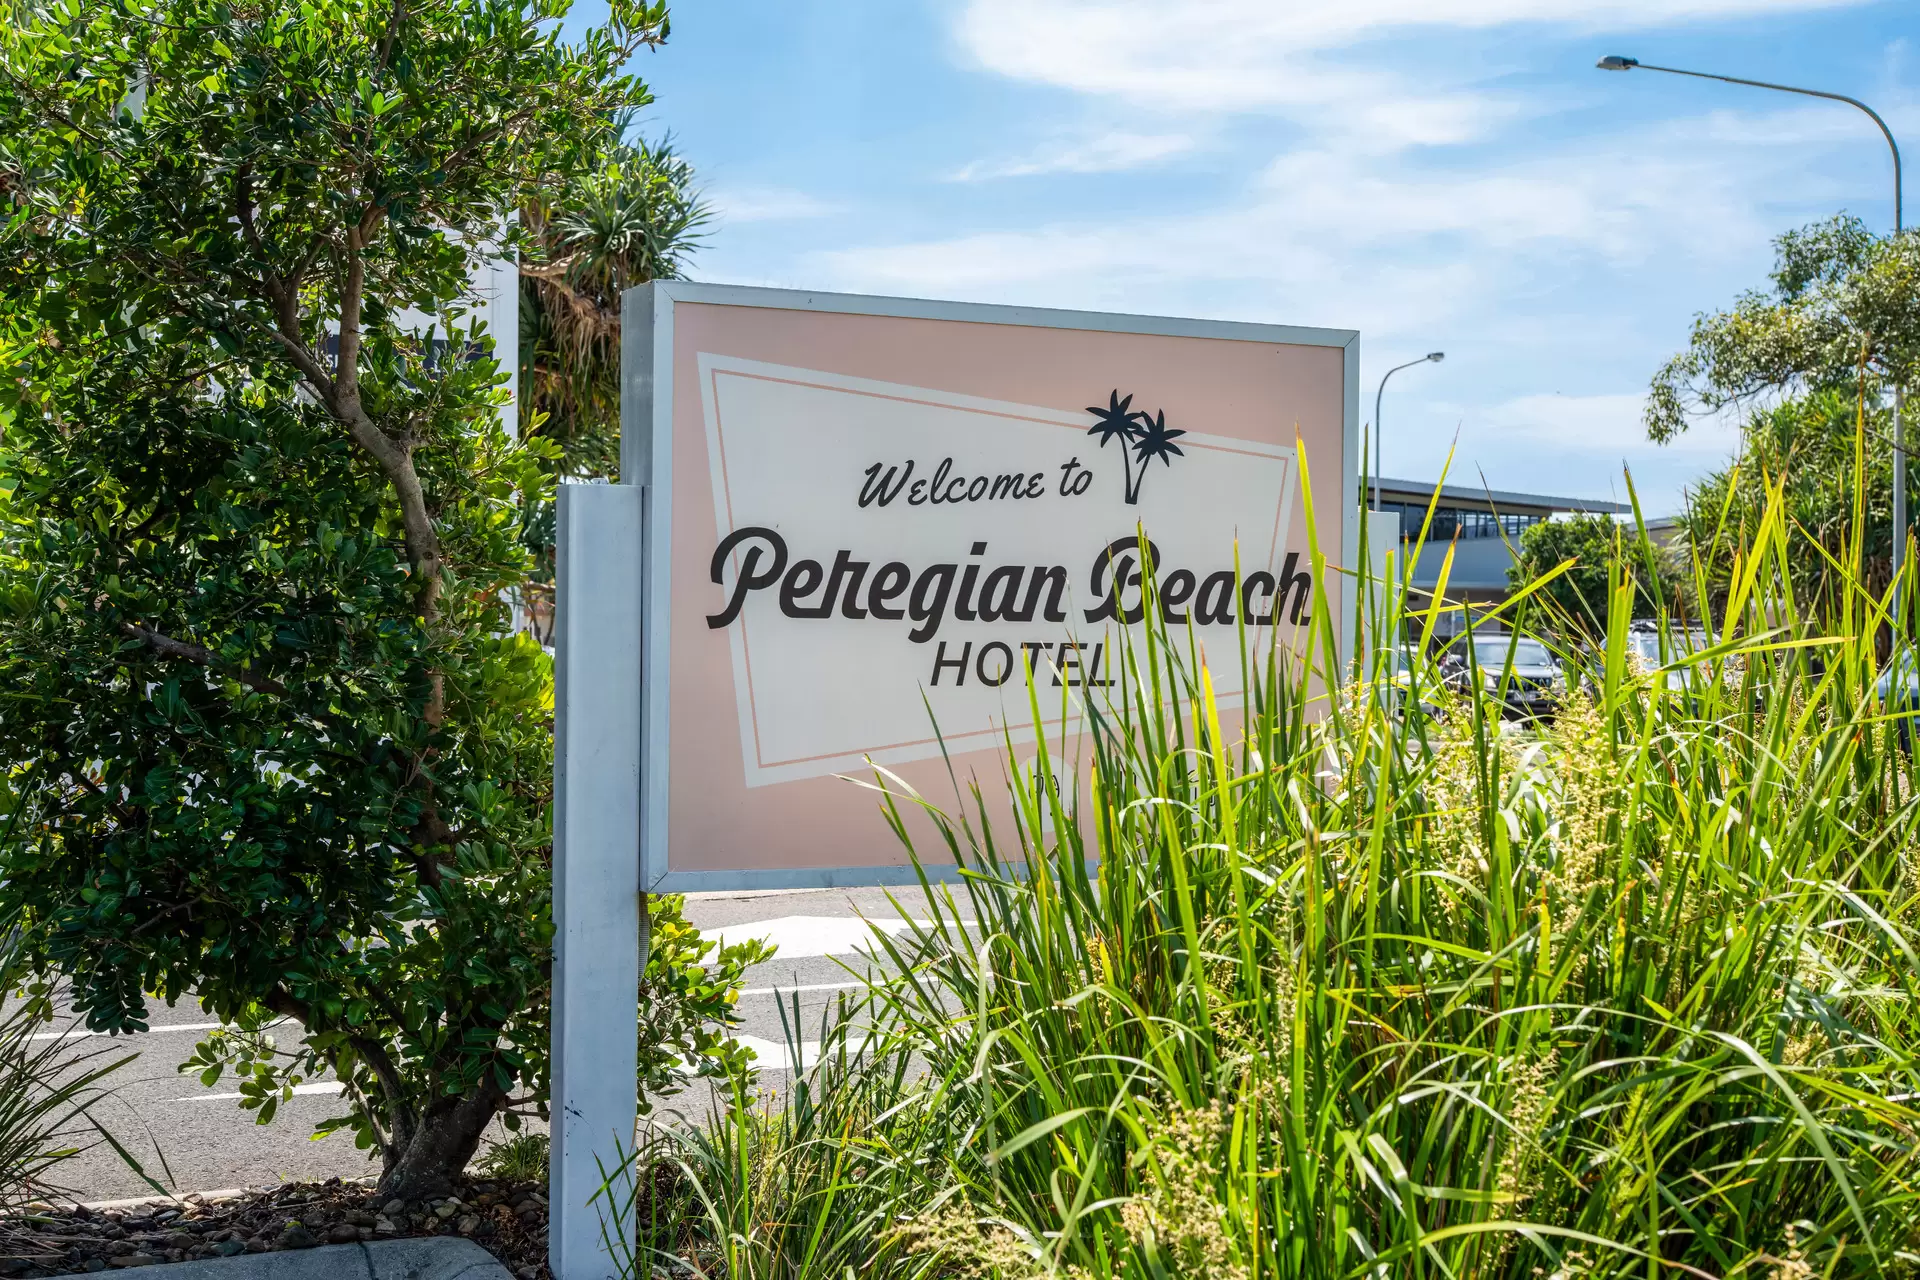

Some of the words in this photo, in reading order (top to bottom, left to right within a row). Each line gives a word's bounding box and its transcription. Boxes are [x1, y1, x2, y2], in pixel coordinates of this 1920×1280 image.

[857, 457, 1045, 509] Welcome
[1059, 456, 1093, 497] to
[705, 526, 1067, 644] Peregian
[1083, 535, 1313, 626] Beach
[930, 641, 1116, 687] HOTEL
